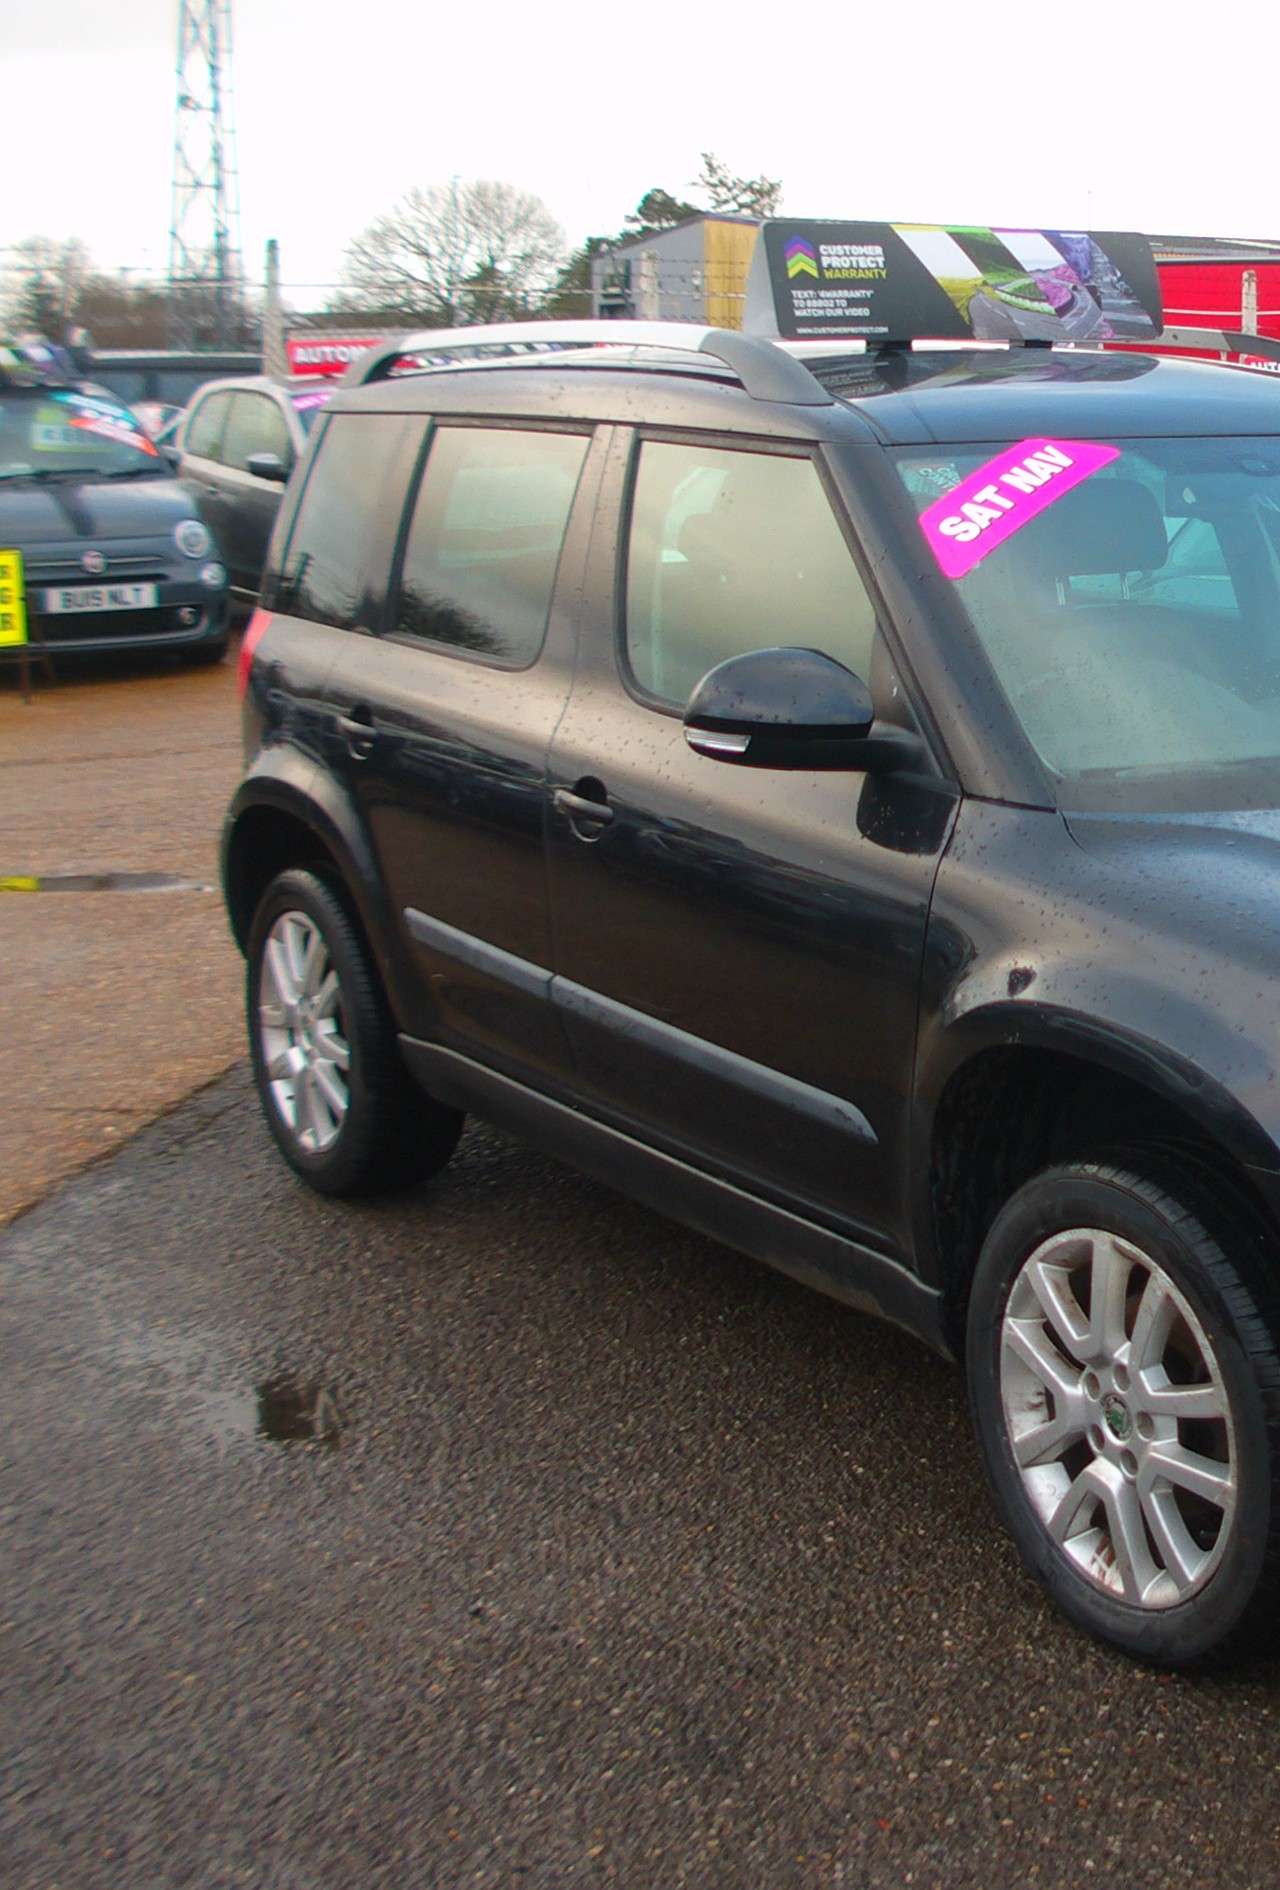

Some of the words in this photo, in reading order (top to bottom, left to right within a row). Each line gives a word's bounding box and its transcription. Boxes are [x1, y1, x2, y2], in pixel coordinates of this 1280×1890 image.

[819, 244, 884, 256] CUSTOMER
[821, 256, 886, 268] PROTECT
[824, 268, 888, 280] WARRANTY
[938, 484, 1016, 543] SAT
[999, 444, 1074, 495] NAV
